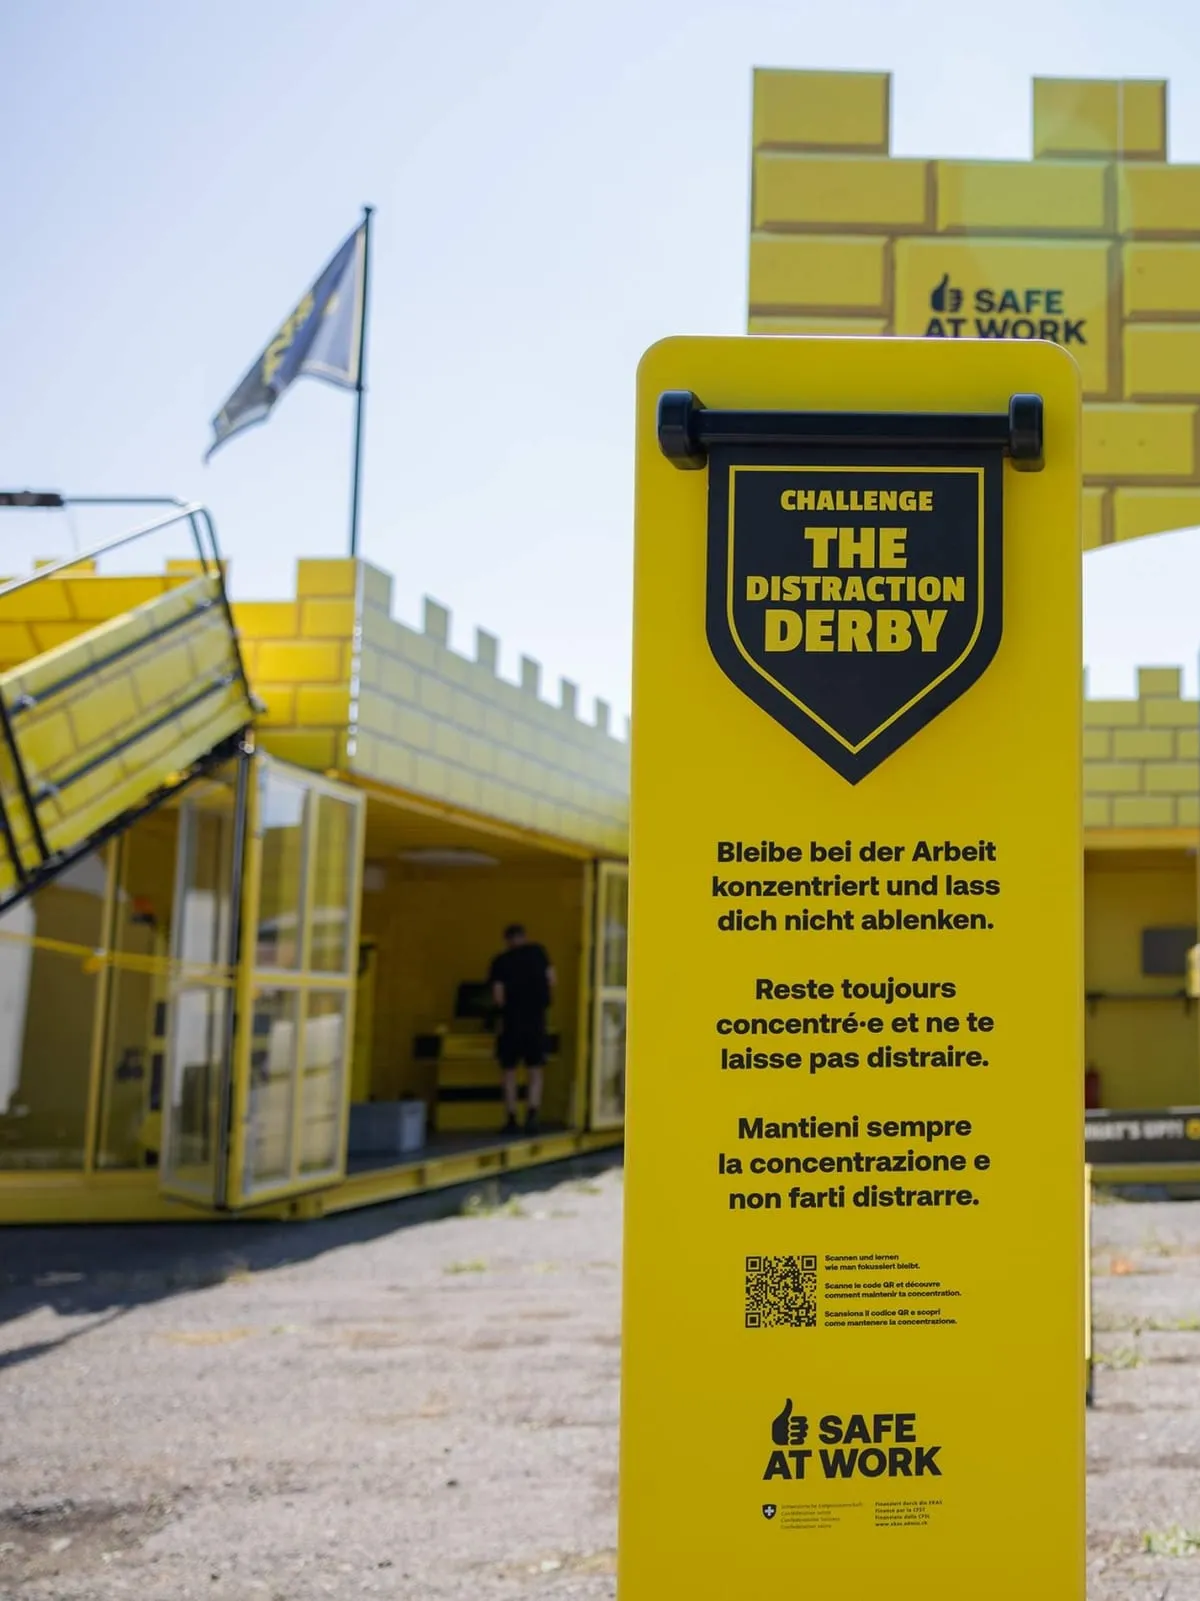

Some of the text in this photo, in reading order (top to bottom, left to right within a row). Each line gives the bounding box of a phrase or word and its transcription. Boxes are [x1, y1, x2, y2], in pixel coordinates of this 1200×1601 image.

[975, 289, 1063, 314] SAFE
[923, 318, 1086, 344] AT WORK
[781, 490, 933, 511] CHALLENGE
[804, 527, 907, 568] THE
[747, 576, 964, 601] DISTRACTION
[765, 609, 948, 652] DERBY
[718, 840, 996, 862] Bleibe bei der Arbeit
[713, 874, 1000, 896] konzentriert und lass
[718, 909, 993, 931] dich nicht ablenken.
[756, 977, 956, 1004] Reste toujours
[717, 1012, 994, 1034] concentré·e et ne te
[722, 1045, 989, 1074] laisse pas distraire.
[739, 1115, 971, 1142] Mantieni sempre
[719, 1149, 990, 1174] la concentrazione e
[730, 1185, 979, 1209] non farti distrarre.
[858, 1262, 895, 1270] fokussiert
[905, 1280, 940, 1288] découvre
[908, 1289, 961, 1297] concentration.
[825, 1309, 864, 1317] Scansiona
[871, 1308, 896, 1316] codice
[917, 1308, 940, 1316] scopri
[897, 1317, 957, 1325] concentrazione.
[819, 1413, 916, 1444] SAFE
[763, 1446, 942, 1480] AT WORK
